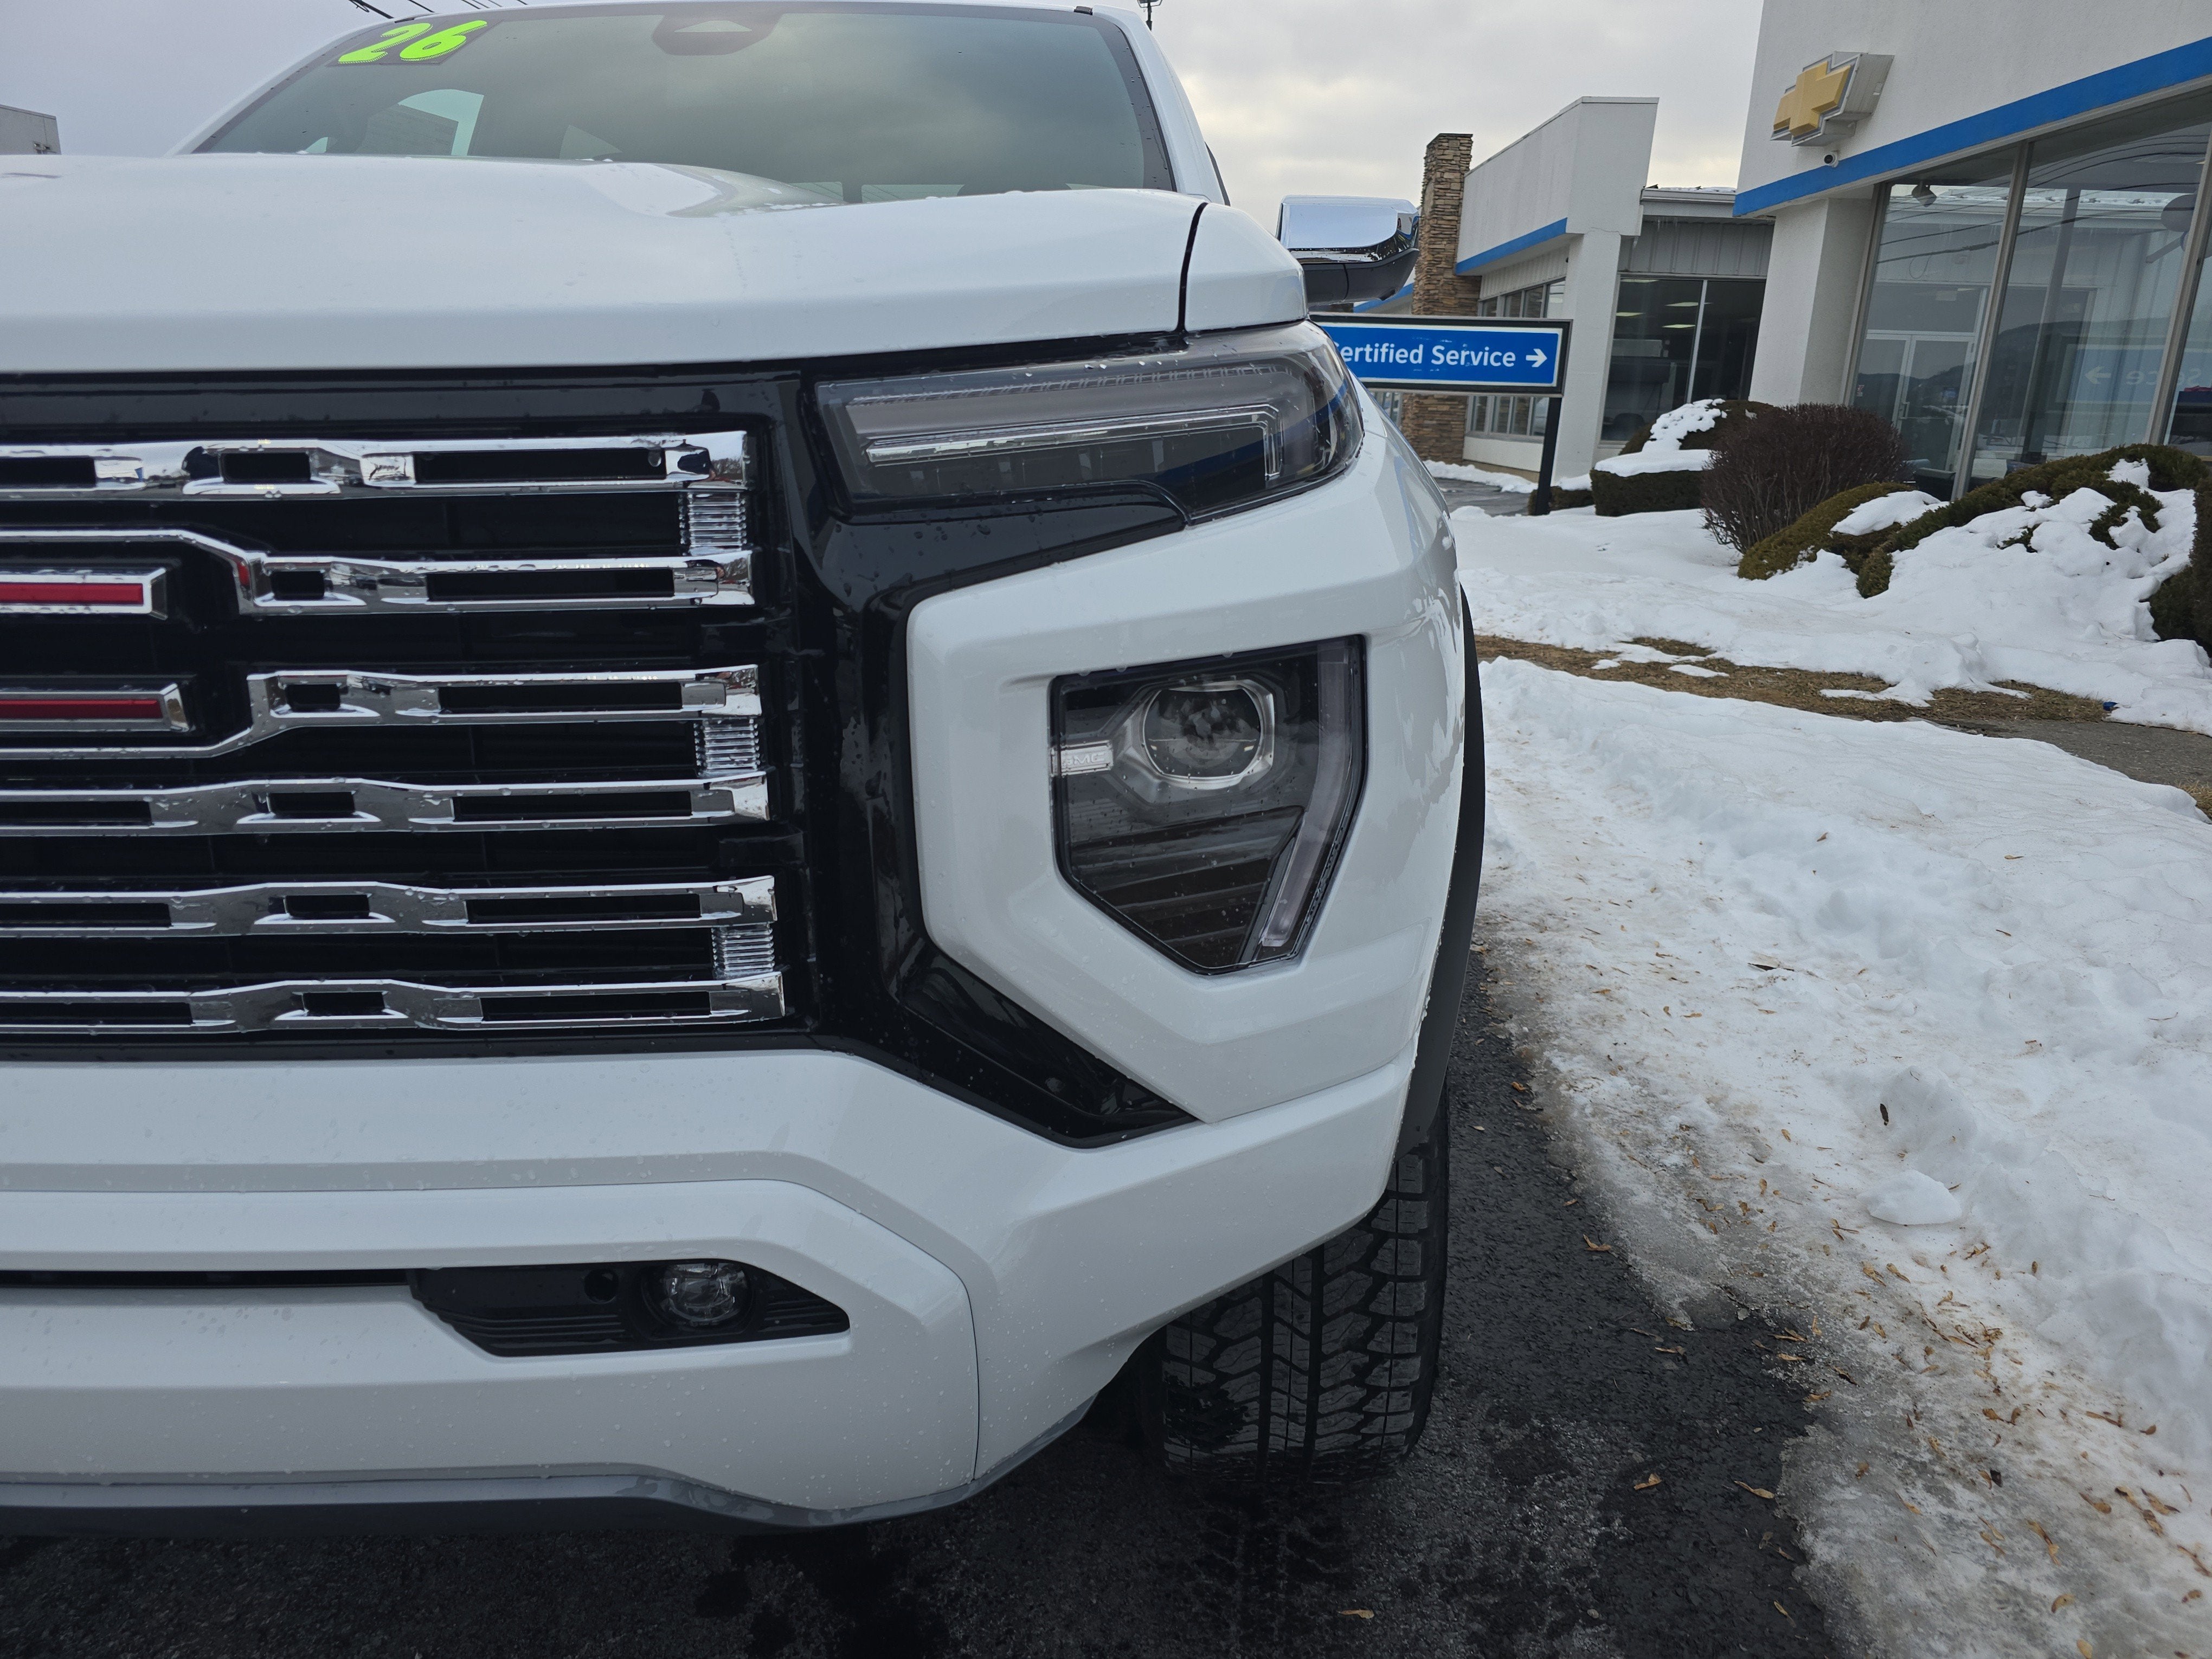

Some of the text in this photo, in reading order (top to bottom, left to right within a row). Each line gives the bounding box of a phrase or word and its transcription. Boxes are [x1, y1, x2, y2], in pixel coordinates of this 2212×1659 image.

[338, 20, 487, 63] 26
[1334, 342, 1516, 367] ertified Service
